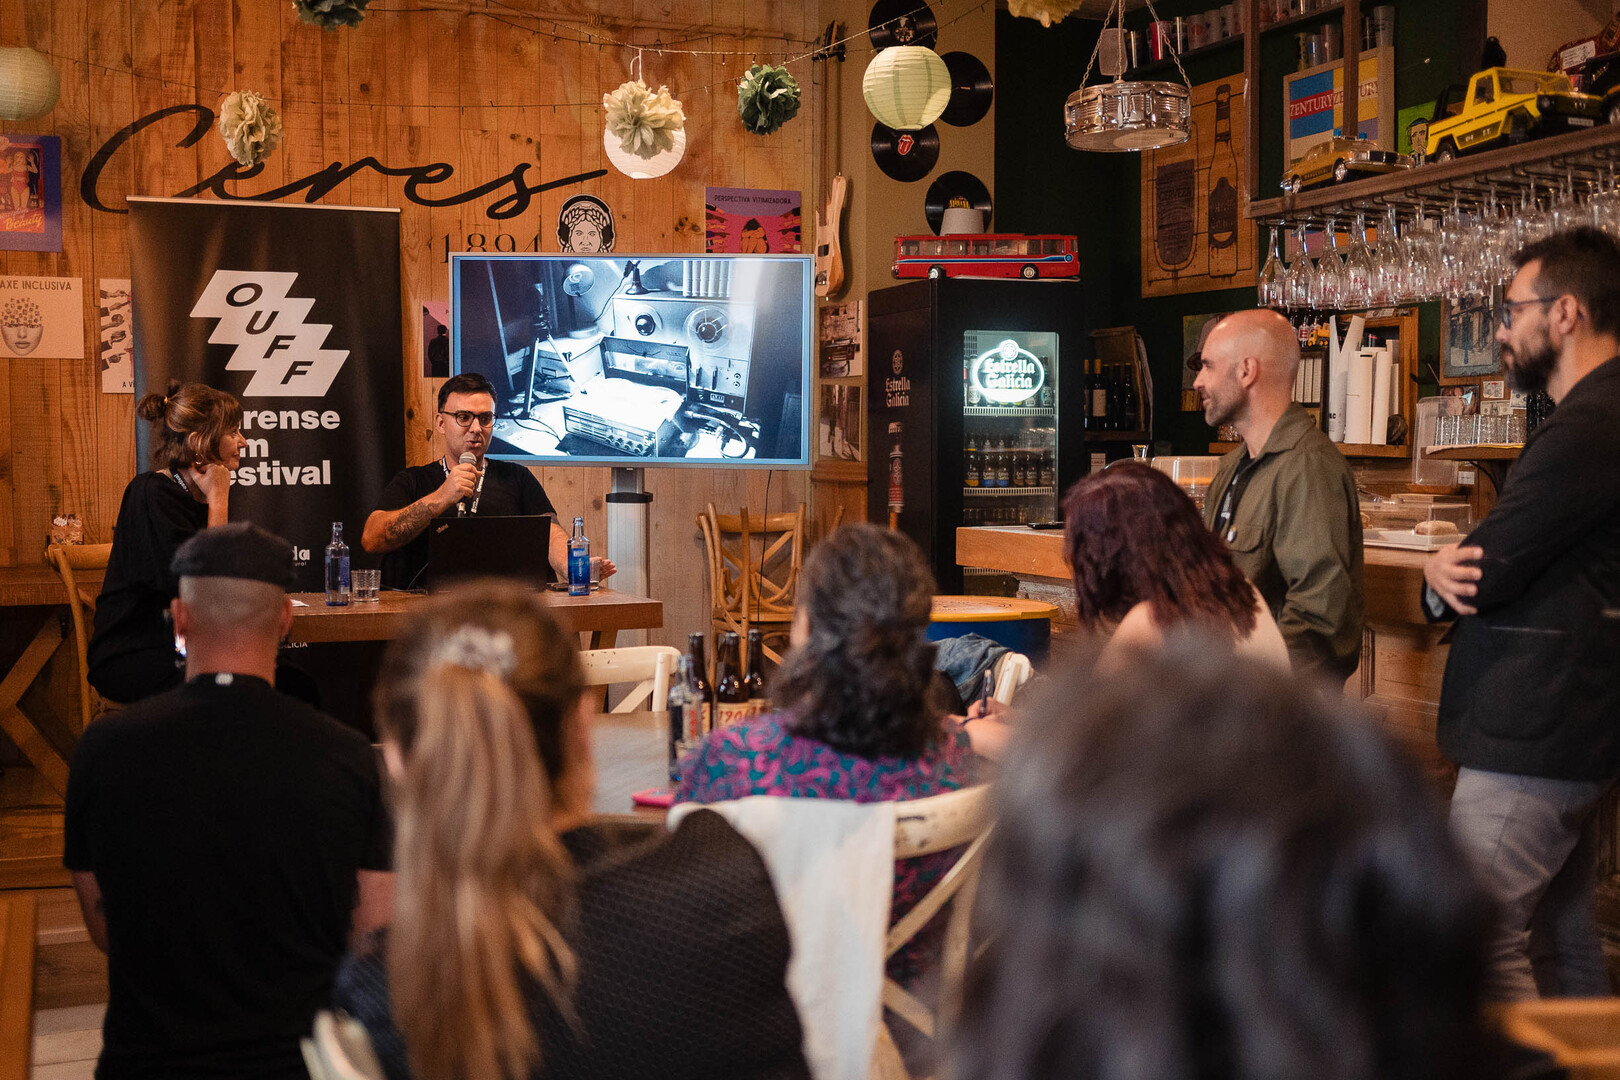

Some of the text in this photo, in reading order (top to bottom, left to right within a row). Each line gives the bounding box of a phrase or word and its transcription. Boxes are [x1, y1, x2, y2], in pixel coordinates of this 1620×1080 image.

[714, 194, 751, 203] PERSPECTIVA
[4, 213, 42, 231] Beauty
[22, 280, 72, 291] INCLUSIVA
[984, 357, 1035, 374] Estrella
[885, 376, 911, 392] Estrella
[985, 372, 1033, 389] Galicia
[886, 392, 910, 408] Galicia
[239, 409, 341, 430] rense
